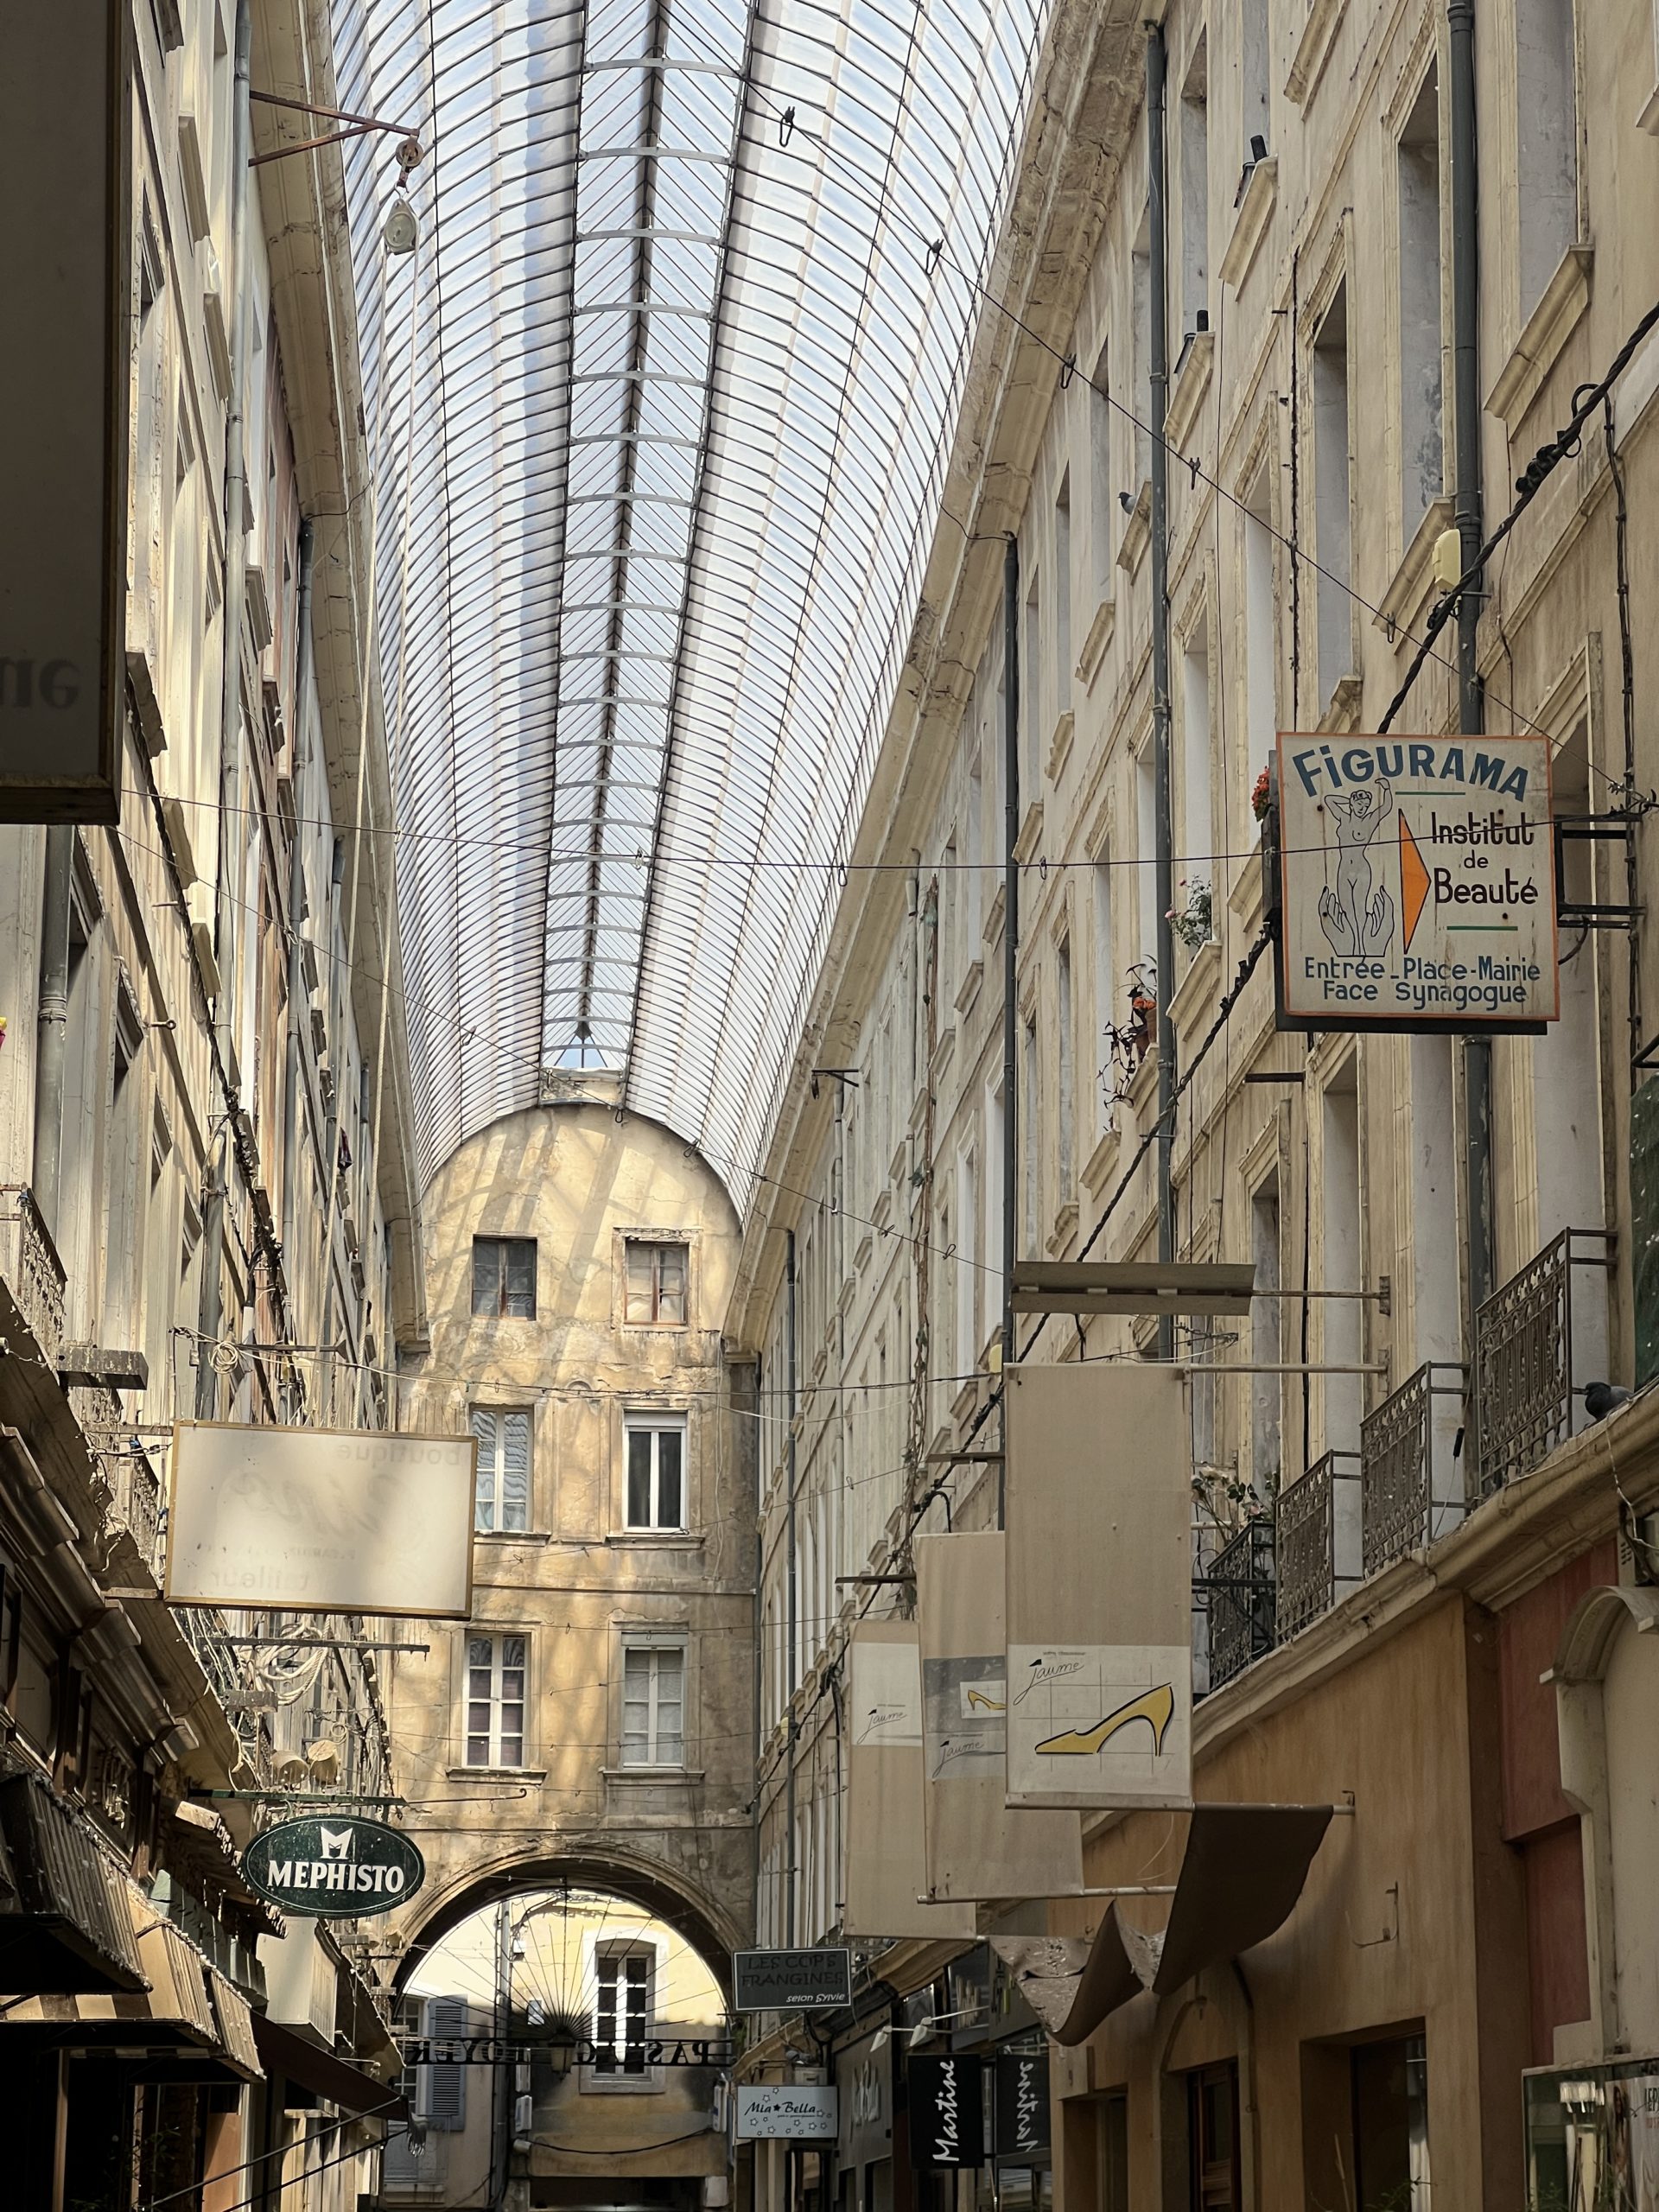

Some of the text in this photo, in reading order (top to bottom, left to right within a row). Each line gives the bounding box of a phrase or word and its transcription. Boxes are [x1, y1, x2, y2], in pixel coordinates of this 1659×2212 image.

[1431, 811, 1535, 846] Institut
[1463, 849, 1489, 869] de
[1433, 868, 1539, 905] Beauté
[1305, 957, 1386, 981] Entrée
[1323, 982, 1528, 1011] Face Synagogue
[267, 1859, 404, 1893] MEPHISTO
[747, 1955, 780, 1971] LES
[741, 1971, 844, 1987] FRANGINES
[785, 1993, 845, 2004] selon Sylvie
[744, 2101, 817, 2116] Mia Bella
[932, 2060, 959, 2162] Martine
